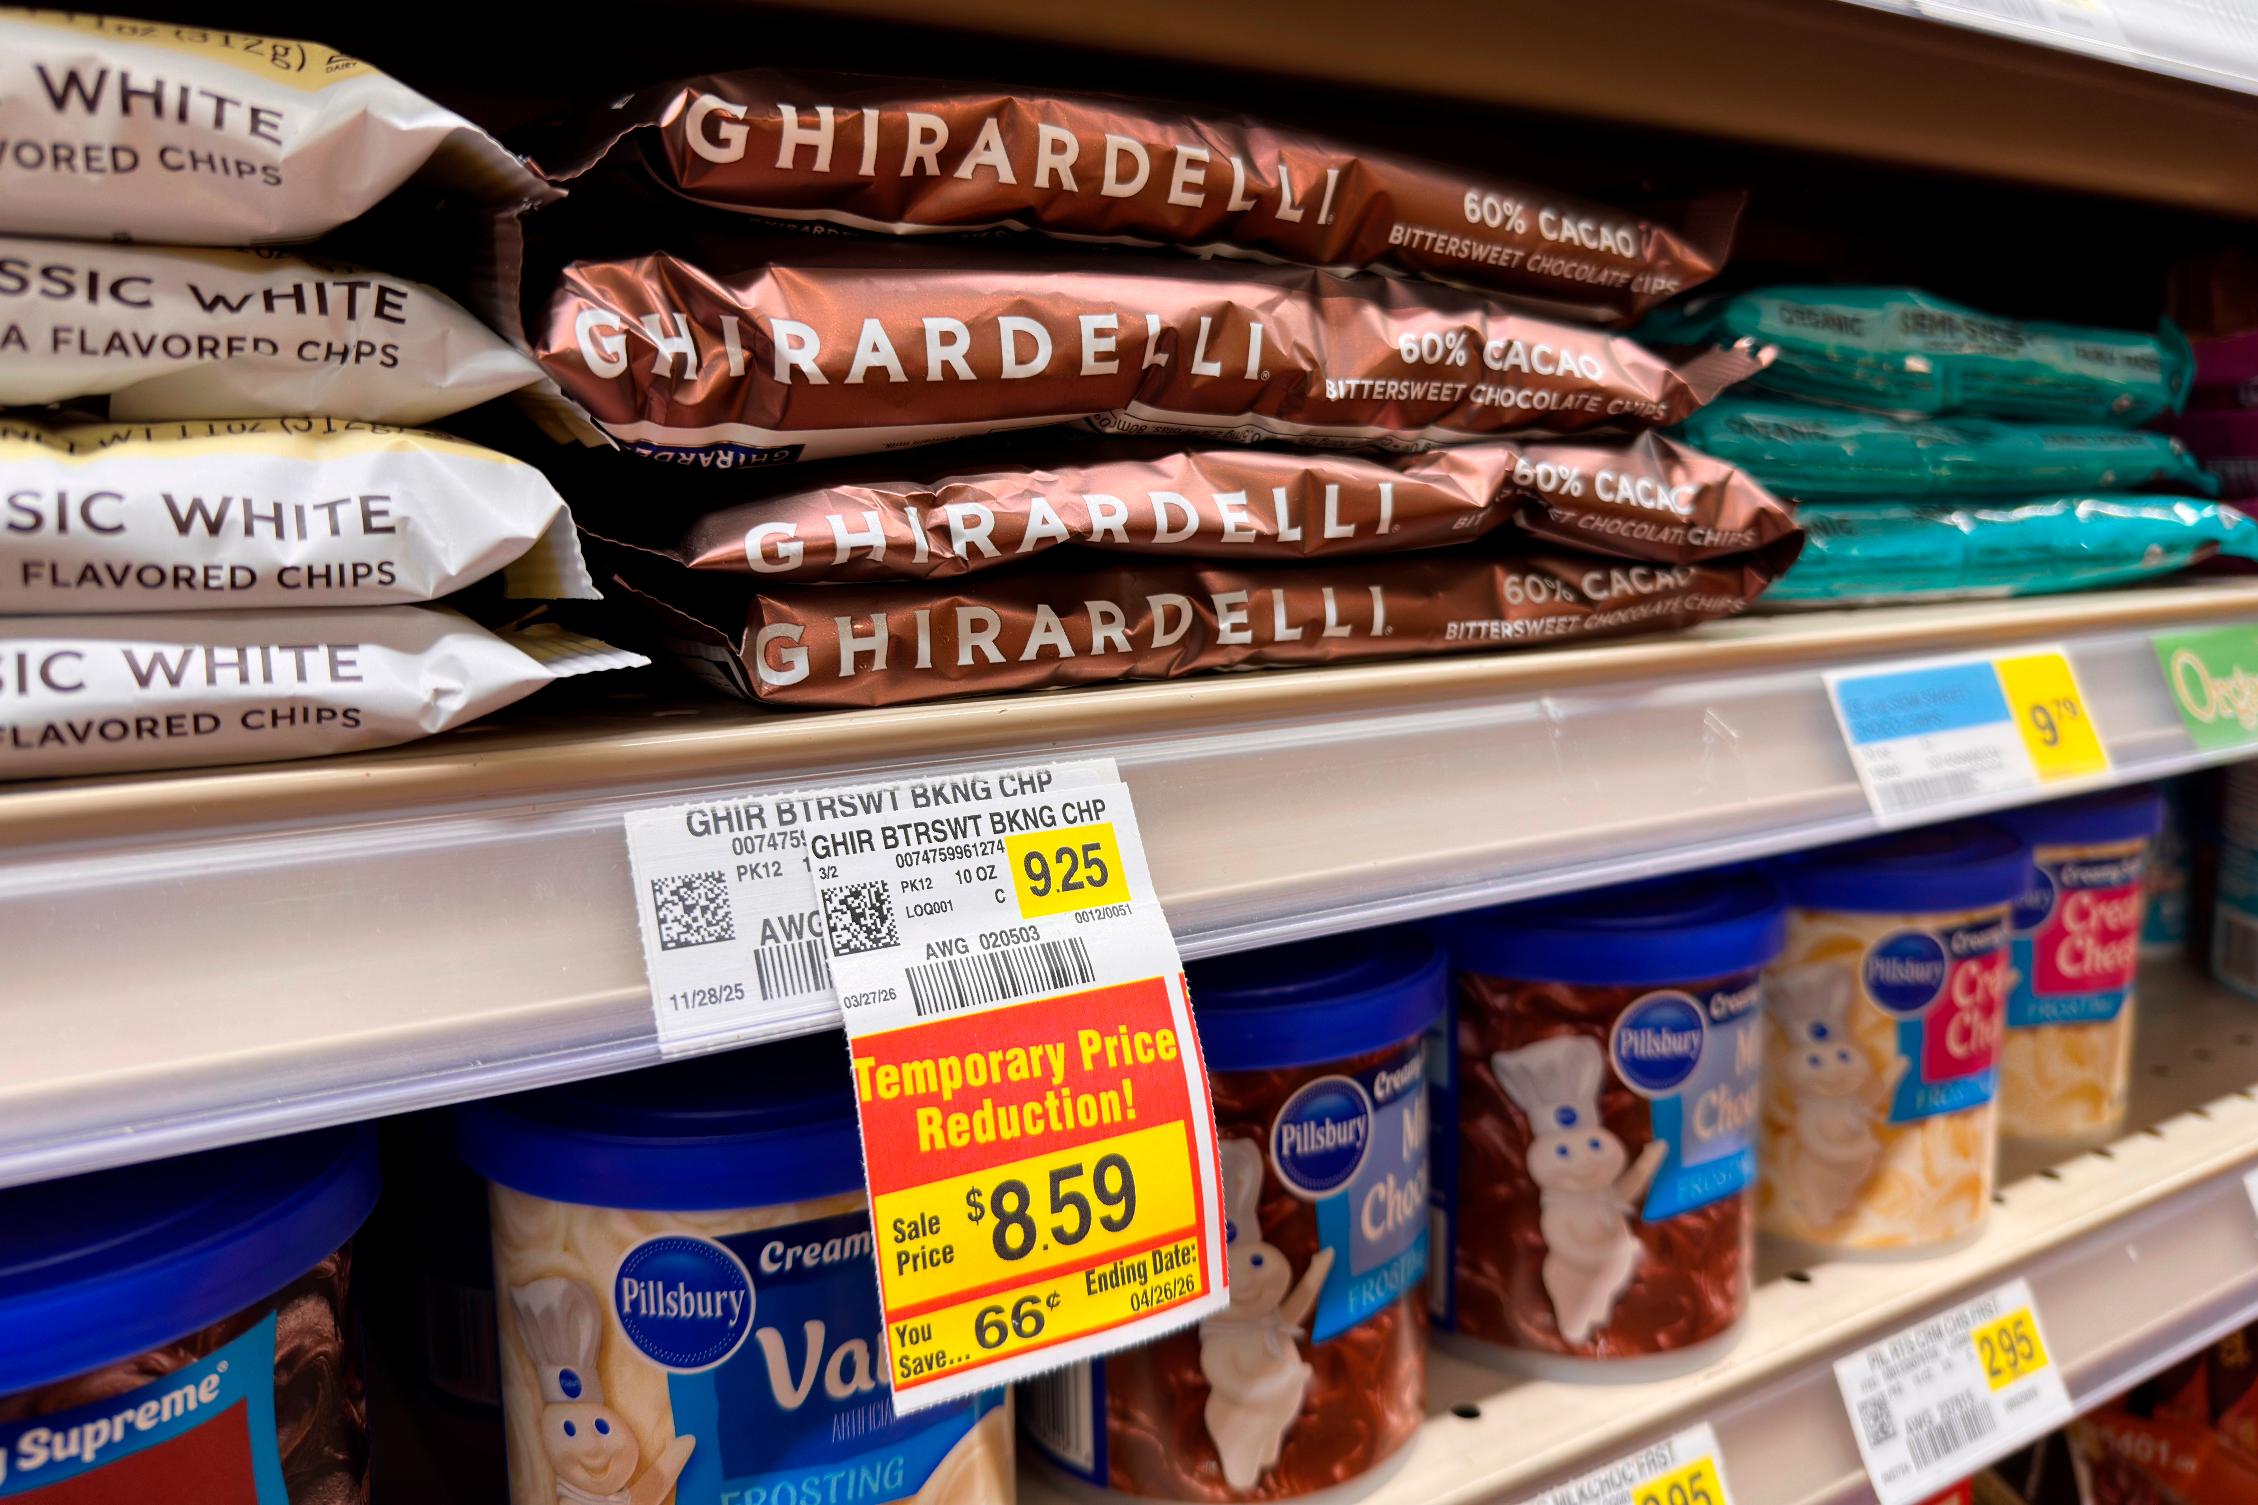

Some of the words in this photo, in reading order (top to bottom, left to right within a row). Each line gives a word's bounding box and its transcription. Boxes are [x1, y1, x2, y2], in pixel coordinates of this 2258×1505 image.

[36, 63, 285, 146] WHITE
[160, 145, 283, 187] CHIPS
[685, 92, 1340, 226] GHIRARDELLI
[1464, 188, 1526, 236] 60%
[1539, 210, 1635, 258] CACAO
[1389, 224, 1525, 268] BITTERSWEET
[1527, 254, 1631, 288] CHOCOLATE
[187, 280, 409, 325] WHITE
[52, 325, 280, 360] FLAVORED
[574, 307, 1265, 386] GHIRARDELLI
[1397, 332, 1467, 367] 60%
[1483, 340, 1603, 381] CACAO
[1326, 378, 1467, 402] BITTERSWEET
[1470, 384, 1601, 412] CHOCOLATE
[1512, 458, 1583, 498] 60%
[8, 490, 127, 535] SIC
[161, 493, 396, 541] WHITE
[745, 482, 1395, 574] GHIRARDELLI
[1687, 526, 1757, 546] CHIPS
[22, 560, 258, 591] FLAVORED
[276, 559, 396, 590] CHIPS
[1503, 574, 1574, 605] 60%
[756, 585, 1387, 687] GHIRARDELLI
[1445, 616, 1583, 641] BITTERSWEET
[1583, 597, 1684, 631] CHOCOLATE
[121, 644, 364, 690] WHITE
[241, 707, 362, 732] CHIPS
[686, 800, 767, 838] GHIR
[776, 789, 901, 825] BTRSWT
[910, 777, 992, 810] BKNG
[999, 768, 1053, 798] CHP
[811, 829, 876, 860] GHIR
[883, 814, 982, 850] BTRSWT
[989, 804, 1057, 834] BKNG
[1062, 798, 1106, 824] CHP
[736, 861, 783, 882] PK12
[818, 865, 839, 881] 3/2
[895, 837, 1006, 869] 0074759961274
[1023, 842, 1109, 898] 9.25
[901, 877, 934, 895] PK12
[955, 868, 973, 885] 10
[976, 864, 998, 882] OZ
[994, 888, 1006, 904] C
[1074, 903, 1134, 925] 0012/0051
[925, 936, 970, 961] AWG
[979, 925, 1041, 951] 020503
[1868, 957, 1943, 987] Pillsbury
[670, 983, 745, 1012] 11/28/25
[843, 987, 898, 1010] 03/27/26
[853, 1041, 1066, 1104] Temporary
[1077, 1023, 1178, 1069] Price
[1621, 1027, 1700, 1060] Pillsbury
[916, 1077, 1137, 1153] Reduction!
[1282, 1112, 1367, 1157] Pillsbury
[892, 1212, 941, 1244] Sale
[966, 1153, 1137, 1263] $8.59
[759, 1230, 875, 1274] Cream
[896, 1241, 955, 1276] Price
[1085, 1258, 1149, 1297] Ending
[1152, 1242, 1198, 1278] Date:
[622, 1276, 746, 1328] Pillsbury
[1130, 1274, 1196, 1313] 04/26/26
[896, 1323, 933, 1350] You
[899, 1347, 971, 1380] Save...
[16, 1371, 222, 1472] Supreme
[832, 1397, 898, 1443] ARTIFICIA
